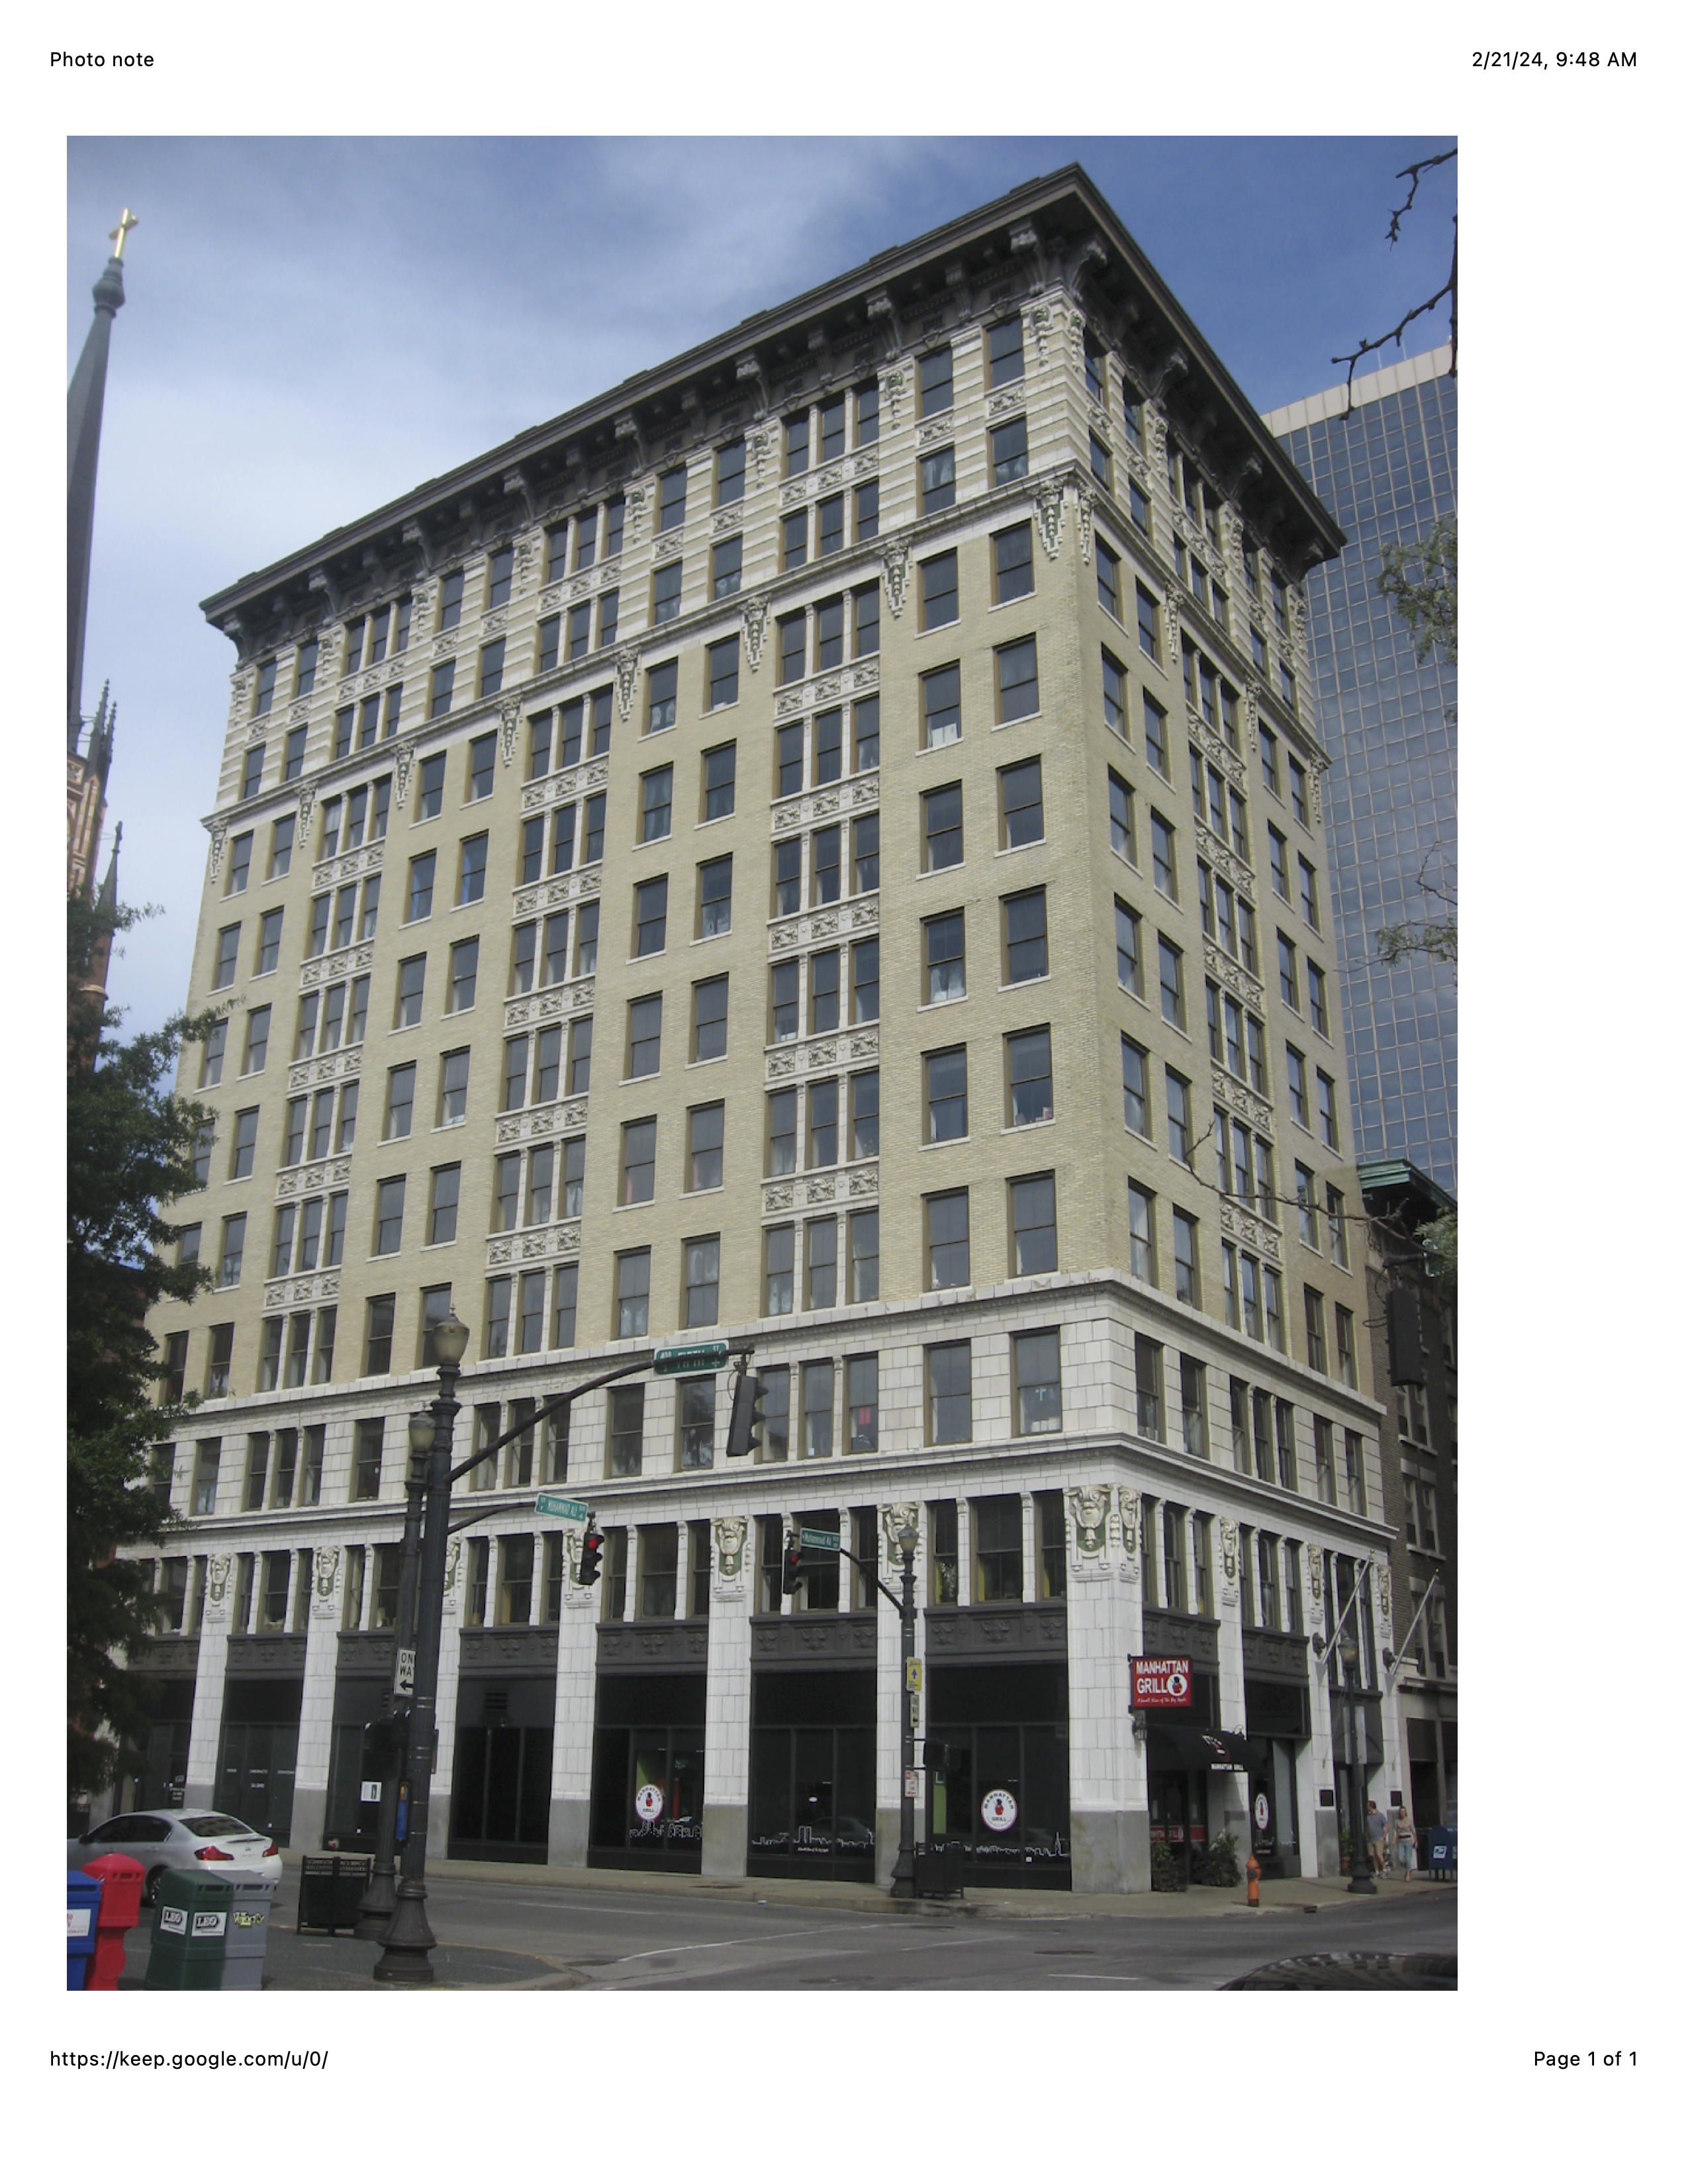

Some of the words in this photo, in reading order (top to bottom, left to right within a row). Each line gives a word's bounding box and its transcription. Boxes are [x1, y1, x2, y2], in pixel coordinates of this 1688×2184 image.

[401, 1653, 413, 1664] ON
[400, 1665, 412, 1677] WA
[1136, 1660, 1188, 1674] MANHATTAN
[1137, 1678, 1168, 1694] GRILL
[165, 1911, 181, 1923] LEO
[196, 1916, 218, 1927] LEO
